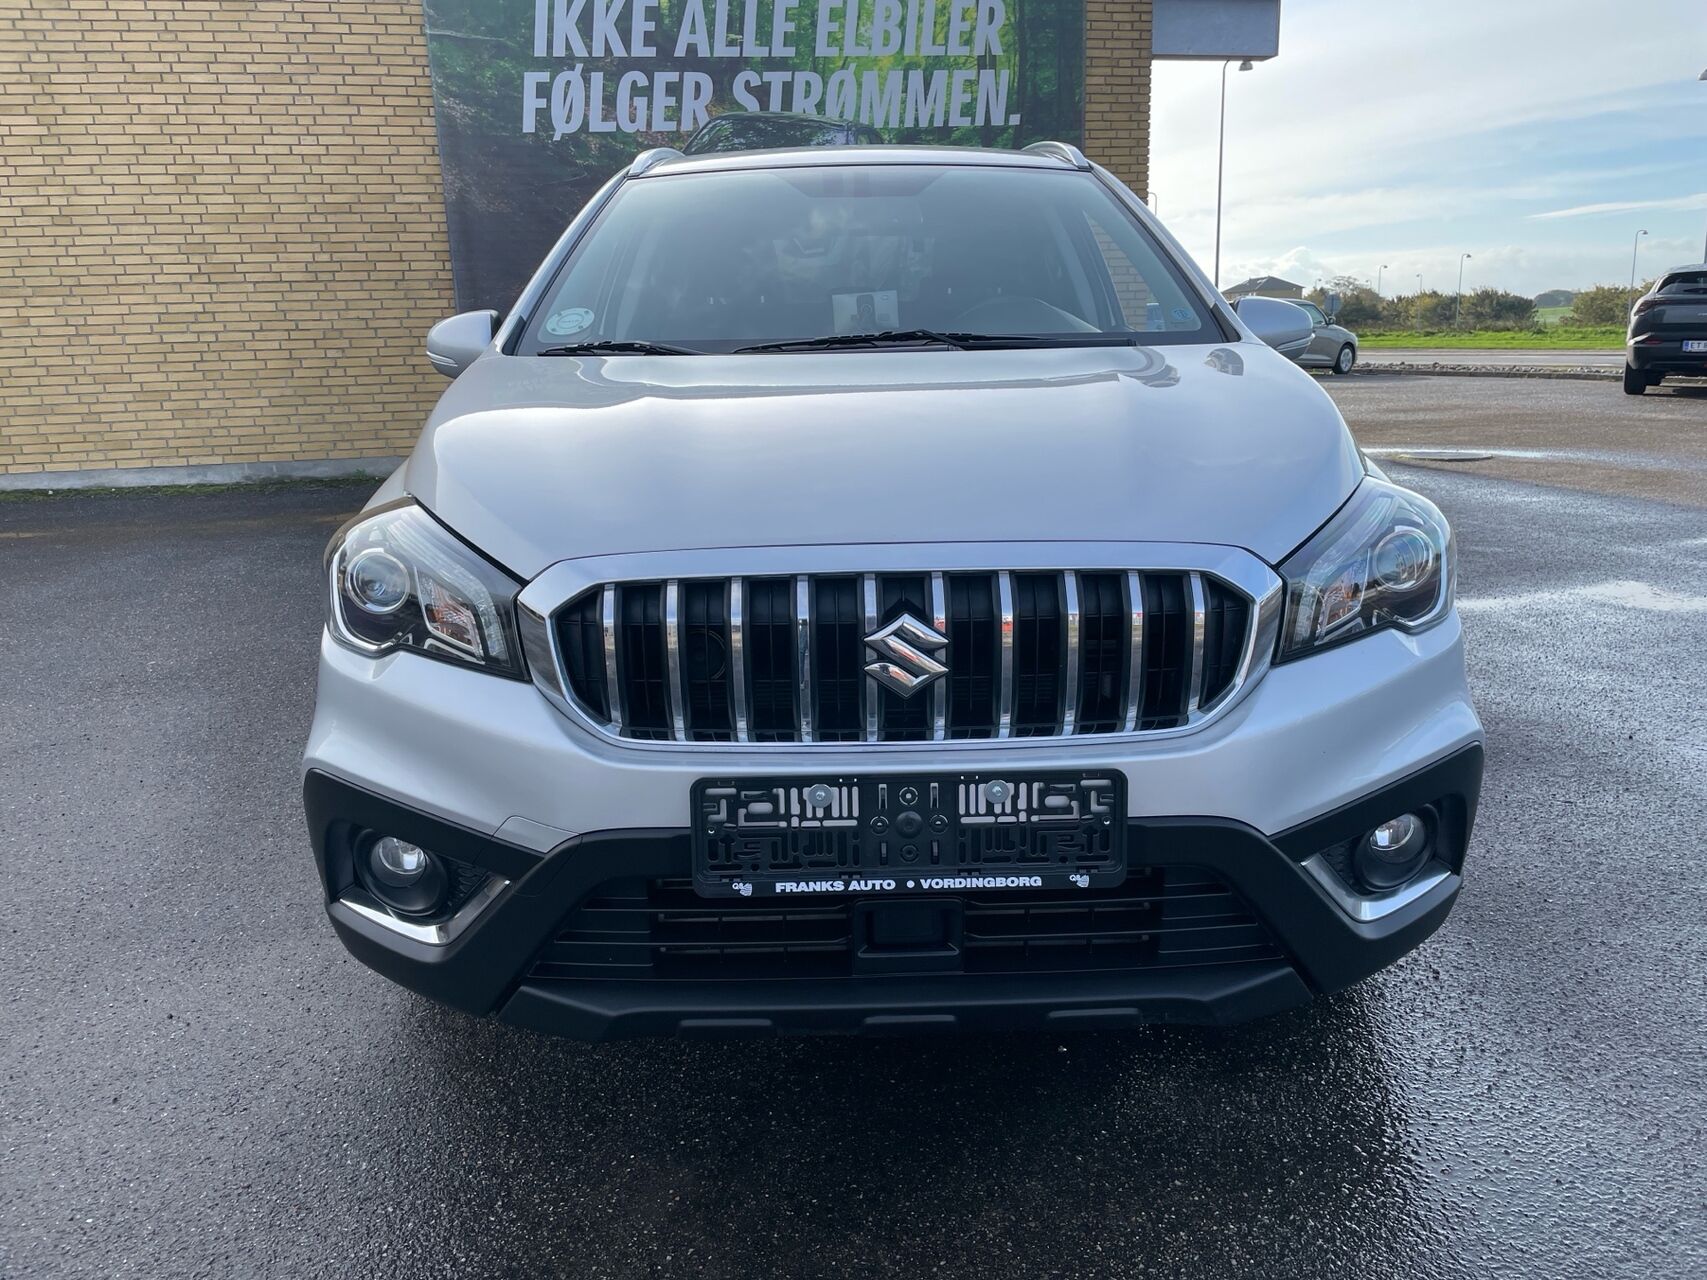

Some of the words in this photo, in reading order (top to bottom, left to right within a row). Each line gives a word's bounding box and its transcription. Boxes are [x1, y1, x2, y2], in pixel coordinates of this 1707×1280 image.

[534, 0, 657, 57] IKKE
[673, 0, 797, 57] ALLE
[815, 0, 1003, 57] ELBILER
[522, 63, 713, 141] FØLGER
[775, 881, 845, 893] FRANKS
[848, 880, 897, 891] AUTO
[919, 876, 1042, 889] VORDINGBORG
